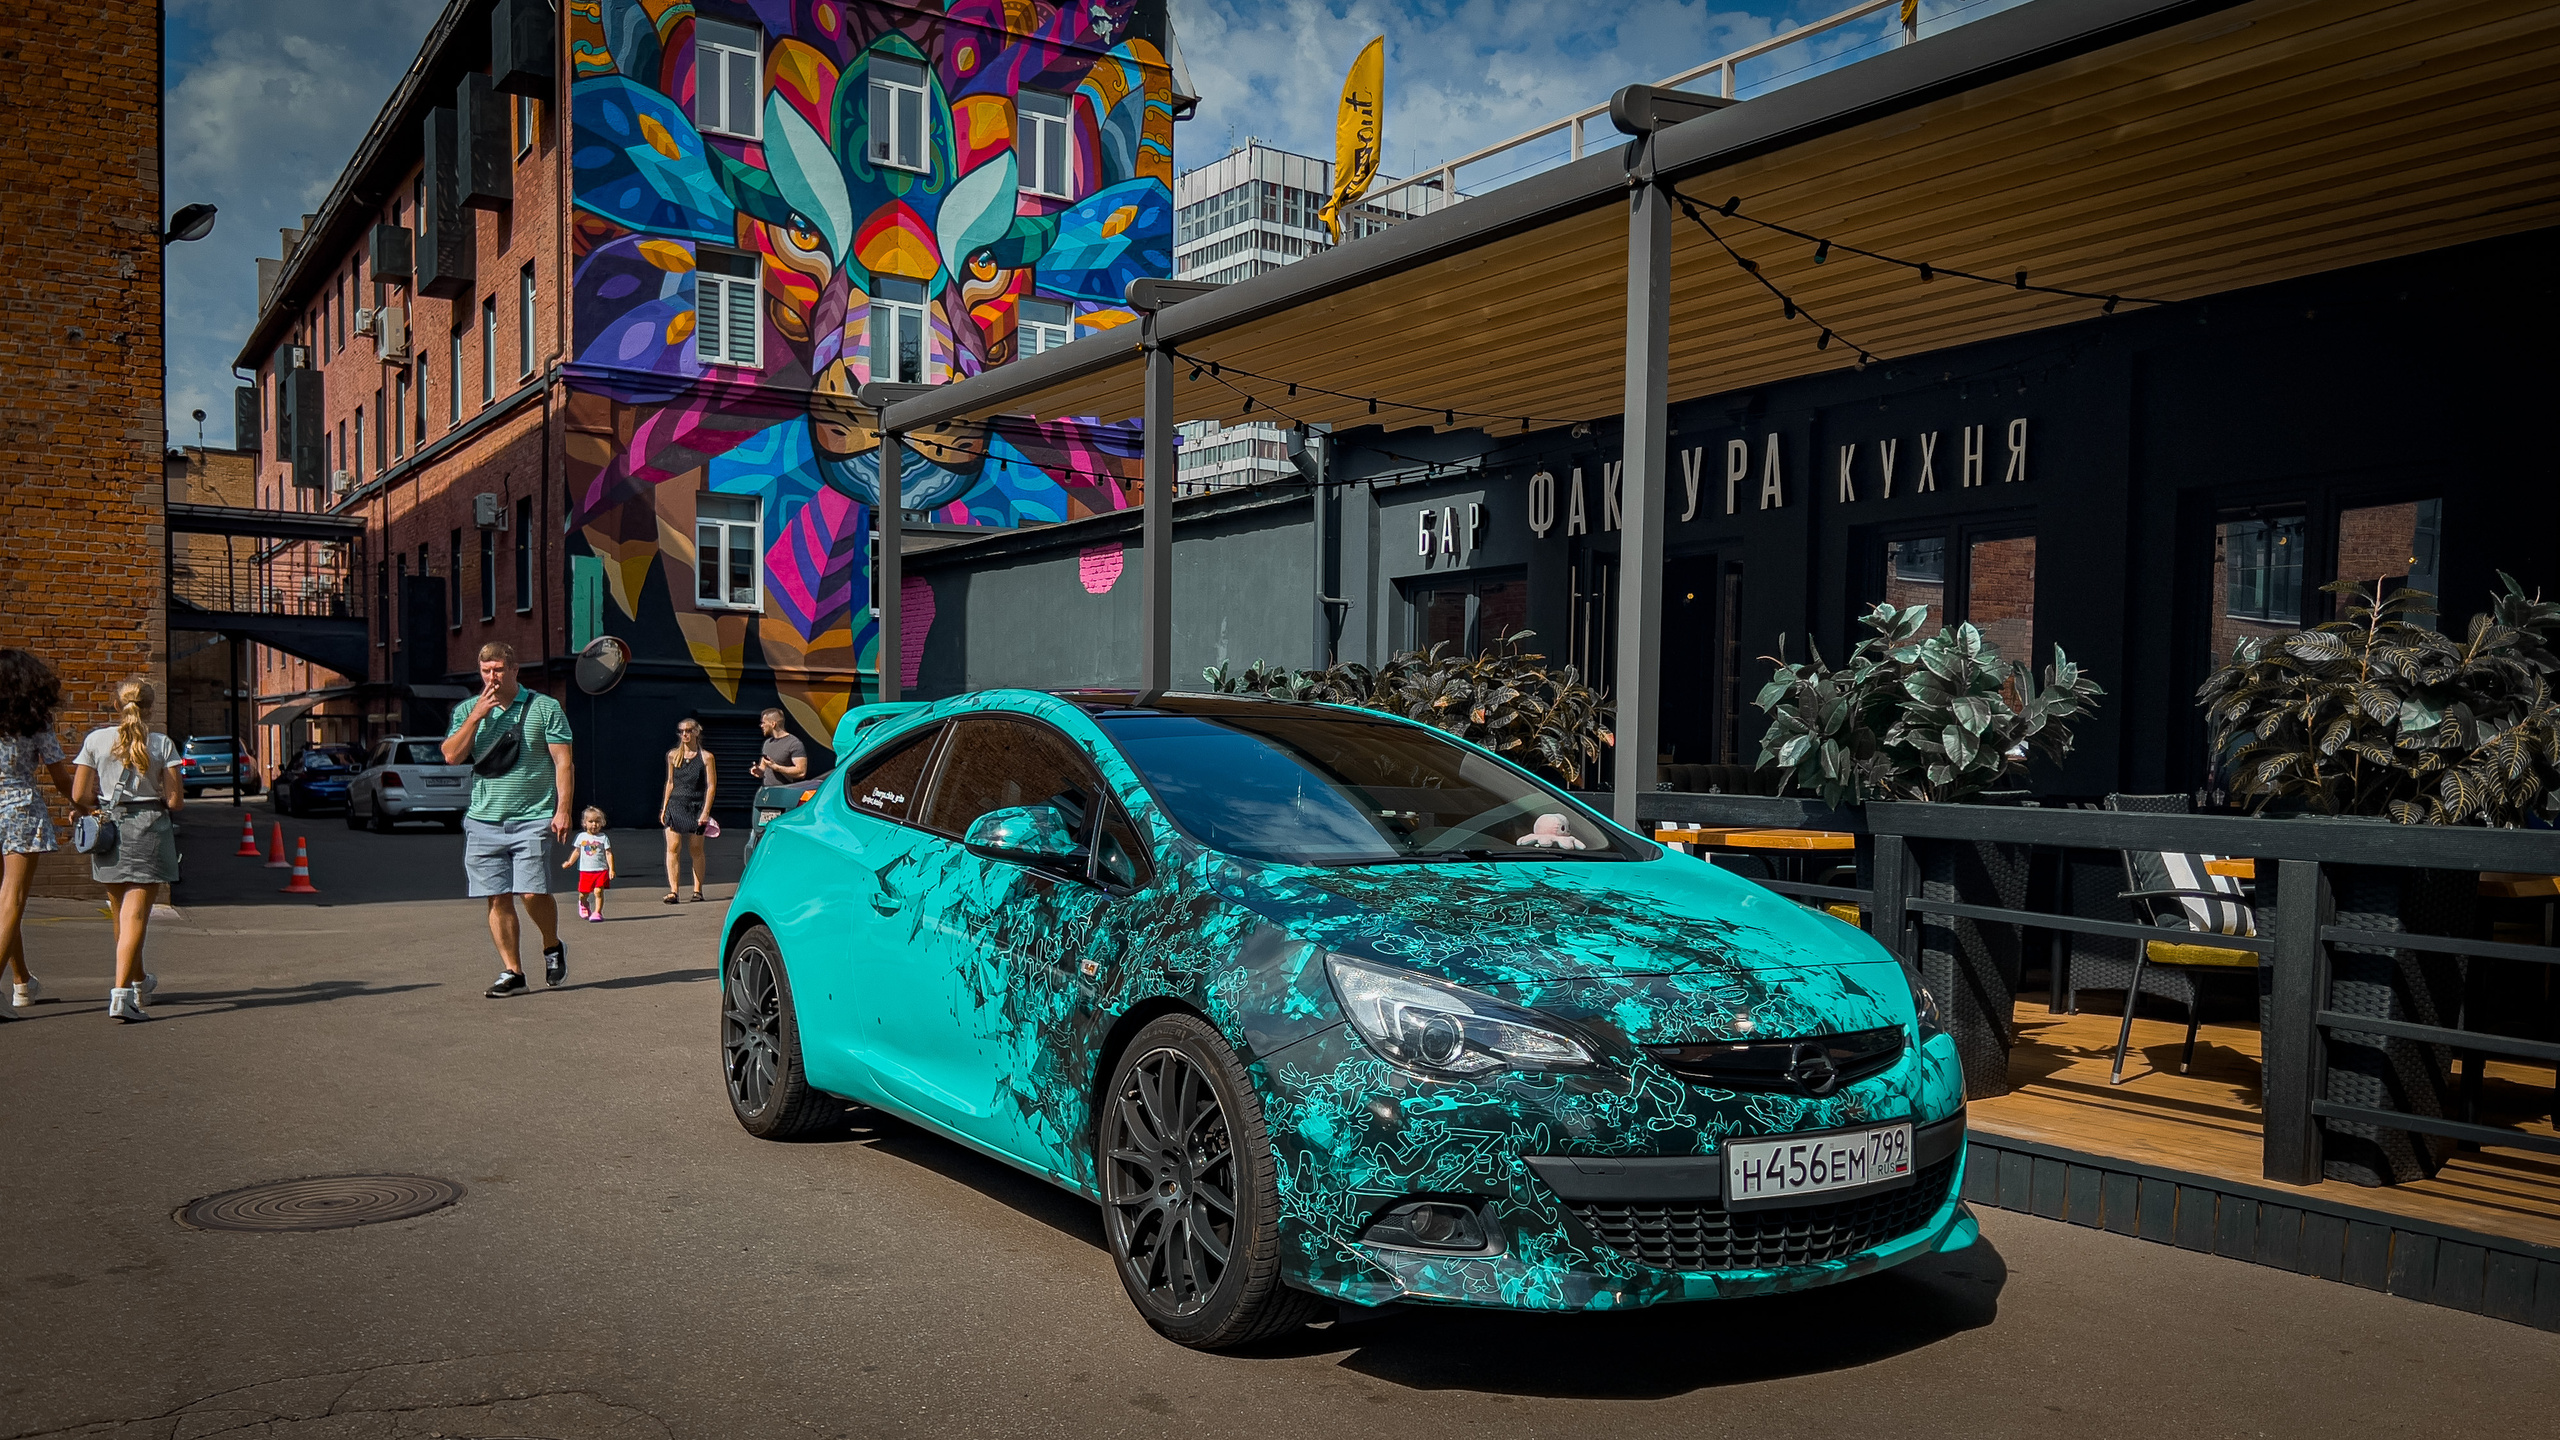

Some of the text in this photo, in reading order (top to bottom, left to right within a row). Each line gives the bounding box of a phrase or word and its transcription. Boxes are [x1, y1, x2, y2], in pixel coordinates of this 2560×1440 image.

[1418, 418, 2027, 556] БАР ФАКУРА КУХНЯ
[1870, 1128, 1905, 1165] 799
[1877, 1161, 1896, 1176] RUS
